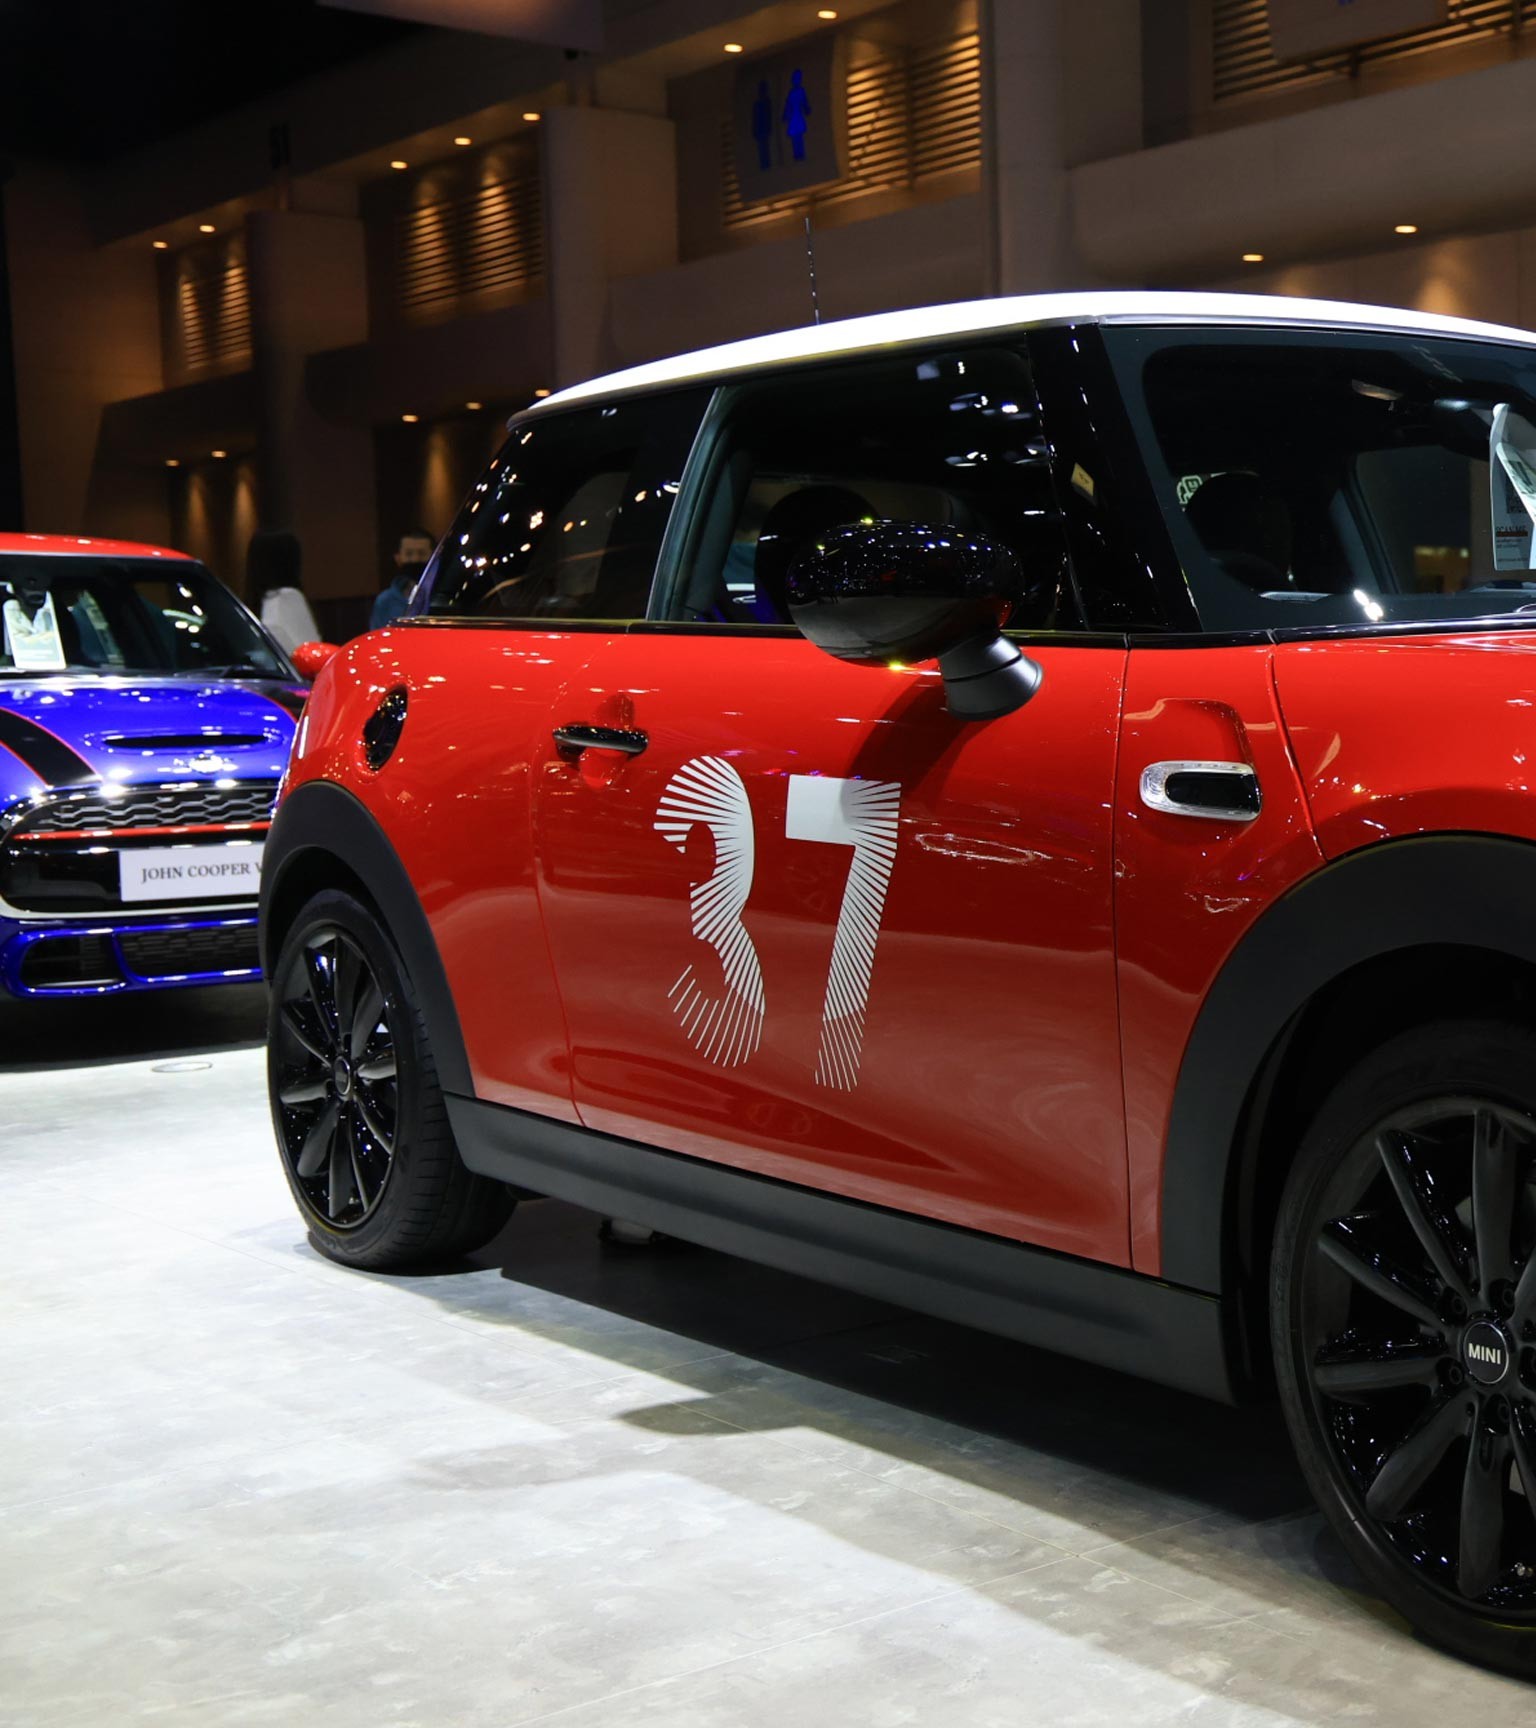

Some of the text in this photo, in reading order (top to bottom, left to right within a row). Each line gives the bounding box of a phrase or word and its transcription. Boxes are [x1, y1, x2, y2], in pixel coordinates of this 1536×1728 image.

[142, 866, 183, 884] JOHN
[187, 863, 252, 878] COOPER
[653, 755, 901, 1091] 37
[1468, 1343, 1501, 1364] MINI
